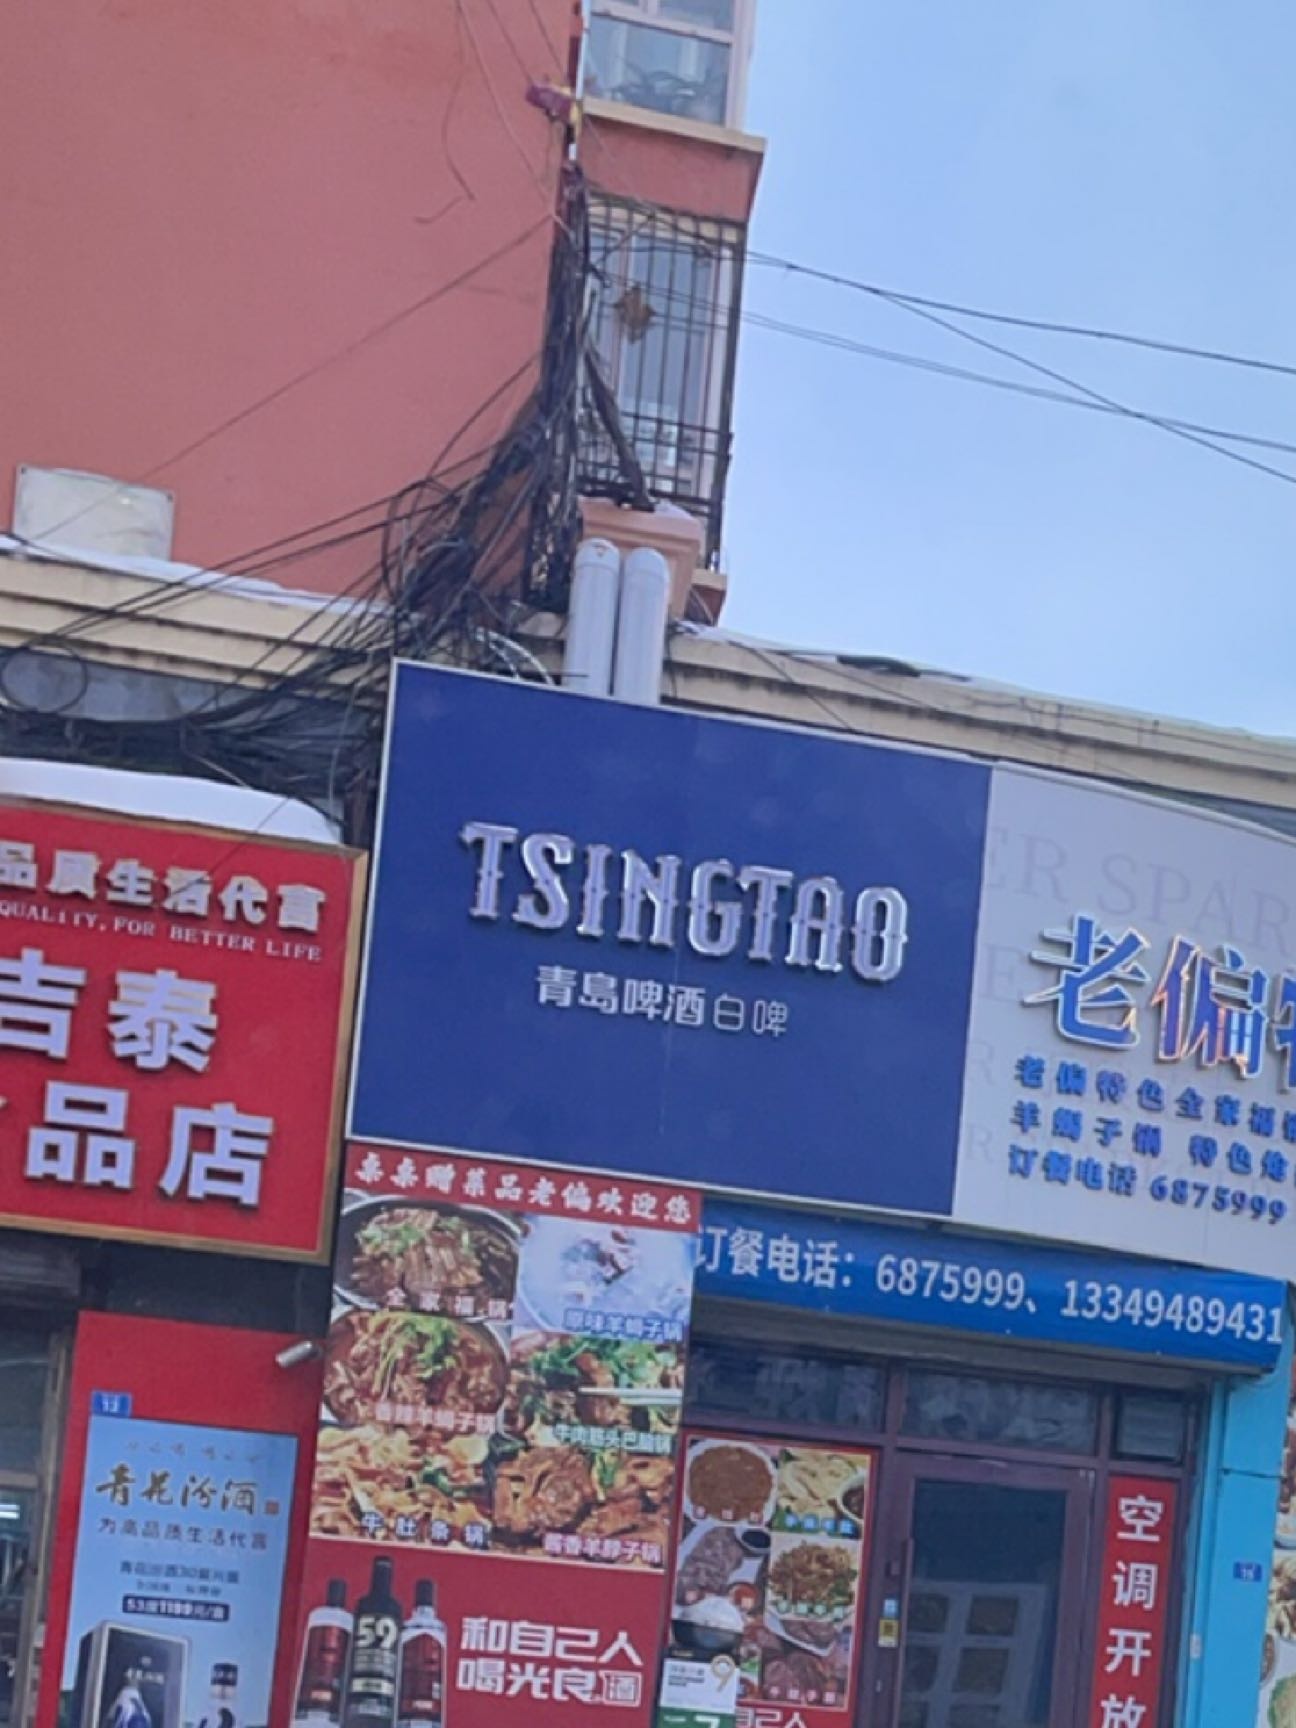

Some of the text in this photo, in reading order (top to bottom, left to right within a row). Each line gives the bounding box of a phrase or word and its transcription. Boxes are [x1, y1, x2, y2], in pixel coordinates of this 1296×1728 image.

[460, 821, 908, 982] TSINGTAO
[170, 924, 255, 952] BETTER
[266, 938, 321, 962] LIFE
[0, 947, 219, 1073] 吉泰
[1008, 1144, 1137, 1198] 订餐电话
[1149, 1173, 1288, 1227] 6875999
[1059, 1279, 1284, 1346] 13349489431
[96, 1463, 259, 1516] 青花汾酒
[357, 1616, 399, 1649] 59
[460, 1615, 644, 1667] 和自己人
